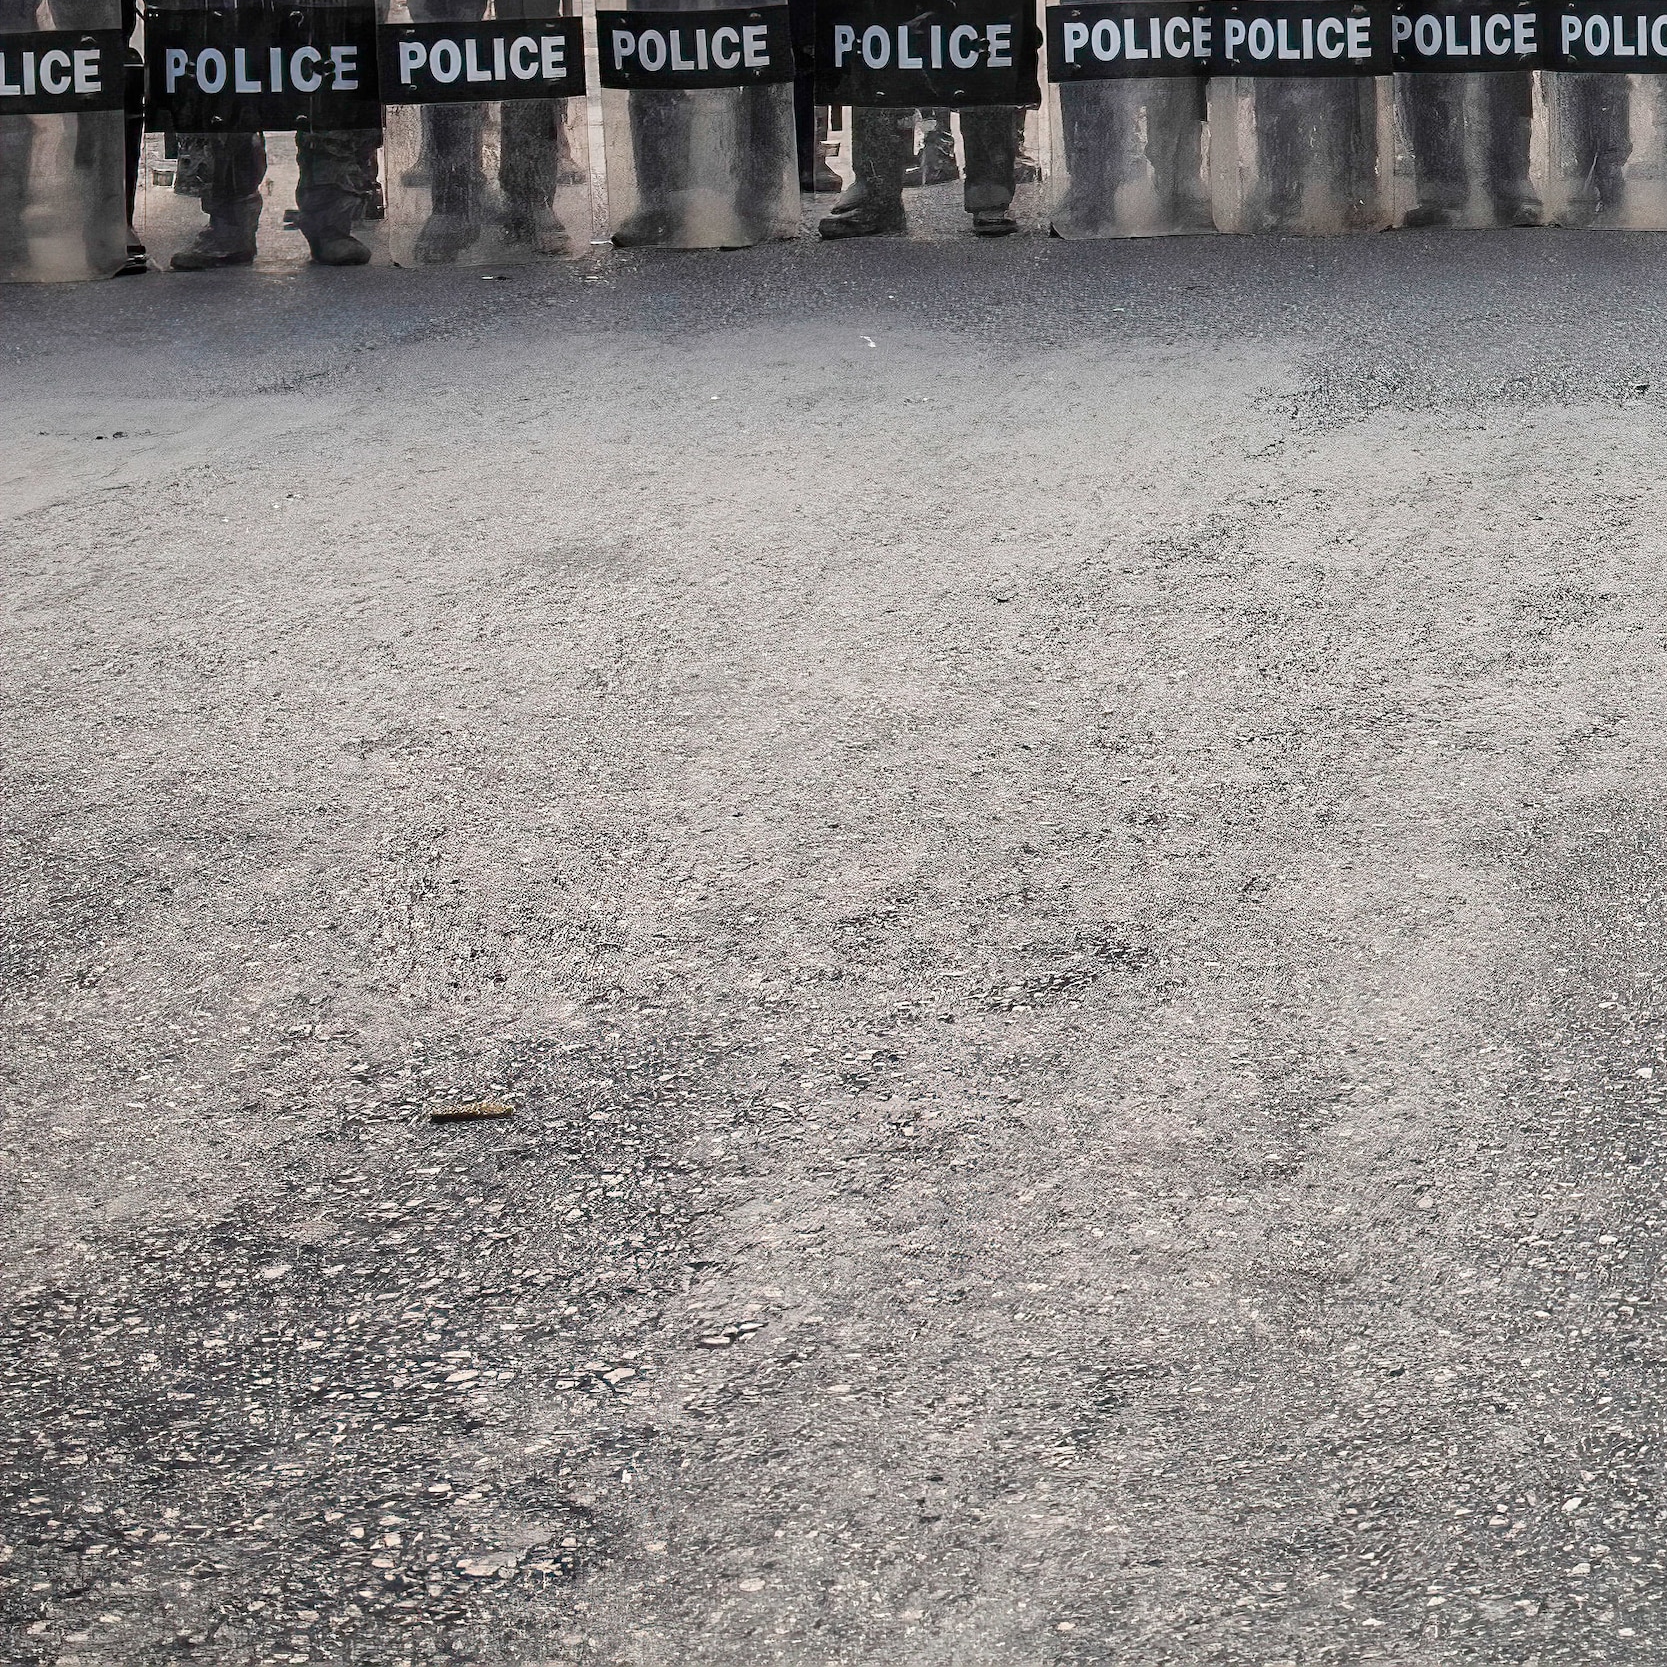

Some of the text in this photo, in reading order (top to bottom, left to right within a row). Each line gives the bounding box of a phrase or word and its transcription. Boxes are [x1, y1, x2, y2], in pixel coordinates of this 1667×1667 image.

[612, 24, 769, 72] POLICE
[835, 24, 1012, 69] POLICE
[1064, 16, 1211, 63] POLICE
[1224, 16, 1371, 60] POLICE
[1392, 13, 1537, 58] POLICE
[0, 50, 101, 95] LICE
[166, 46, 358, 93] POLICE
[399, 36, 567, 84] POLICE
